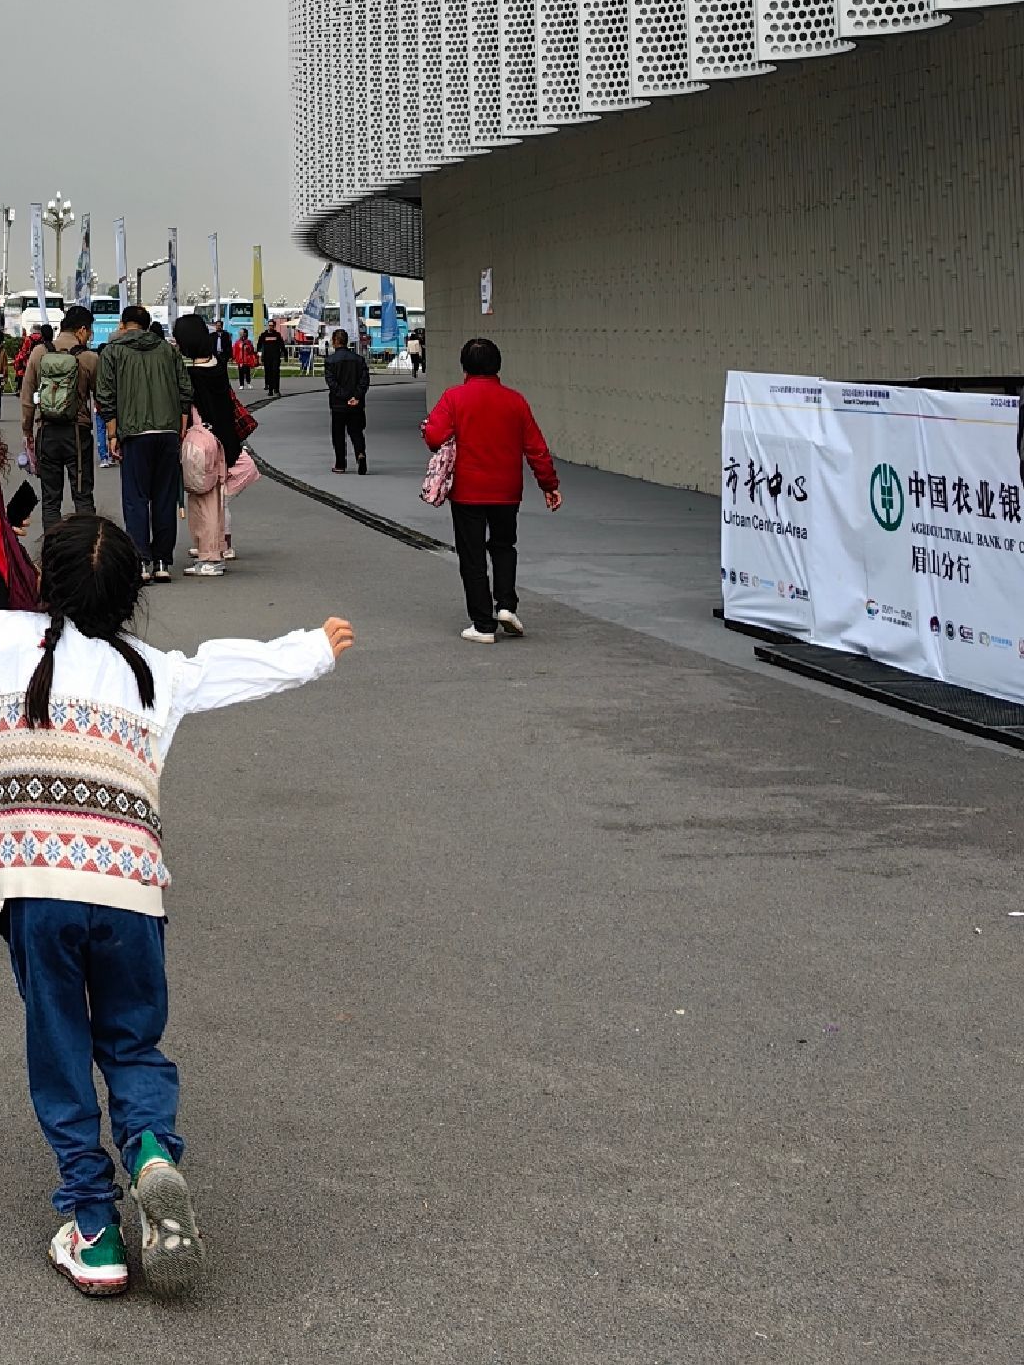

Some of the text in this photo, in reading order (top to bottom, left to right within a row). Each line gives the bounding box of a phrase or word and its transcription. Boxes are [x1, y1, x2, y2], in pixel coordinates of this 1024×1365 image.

[908, 470, 1021, 524] 中国农业银
[723, 509, 752, 528] Urban
[785, 521, 808, 540] Area
[910, 521, 973, 546] AGRICULTURAL
[975, 532, 1002, 550] BANK
[1004, 538, 1016, 552] OF
[912, 544, 971, 584] 眉山分行
